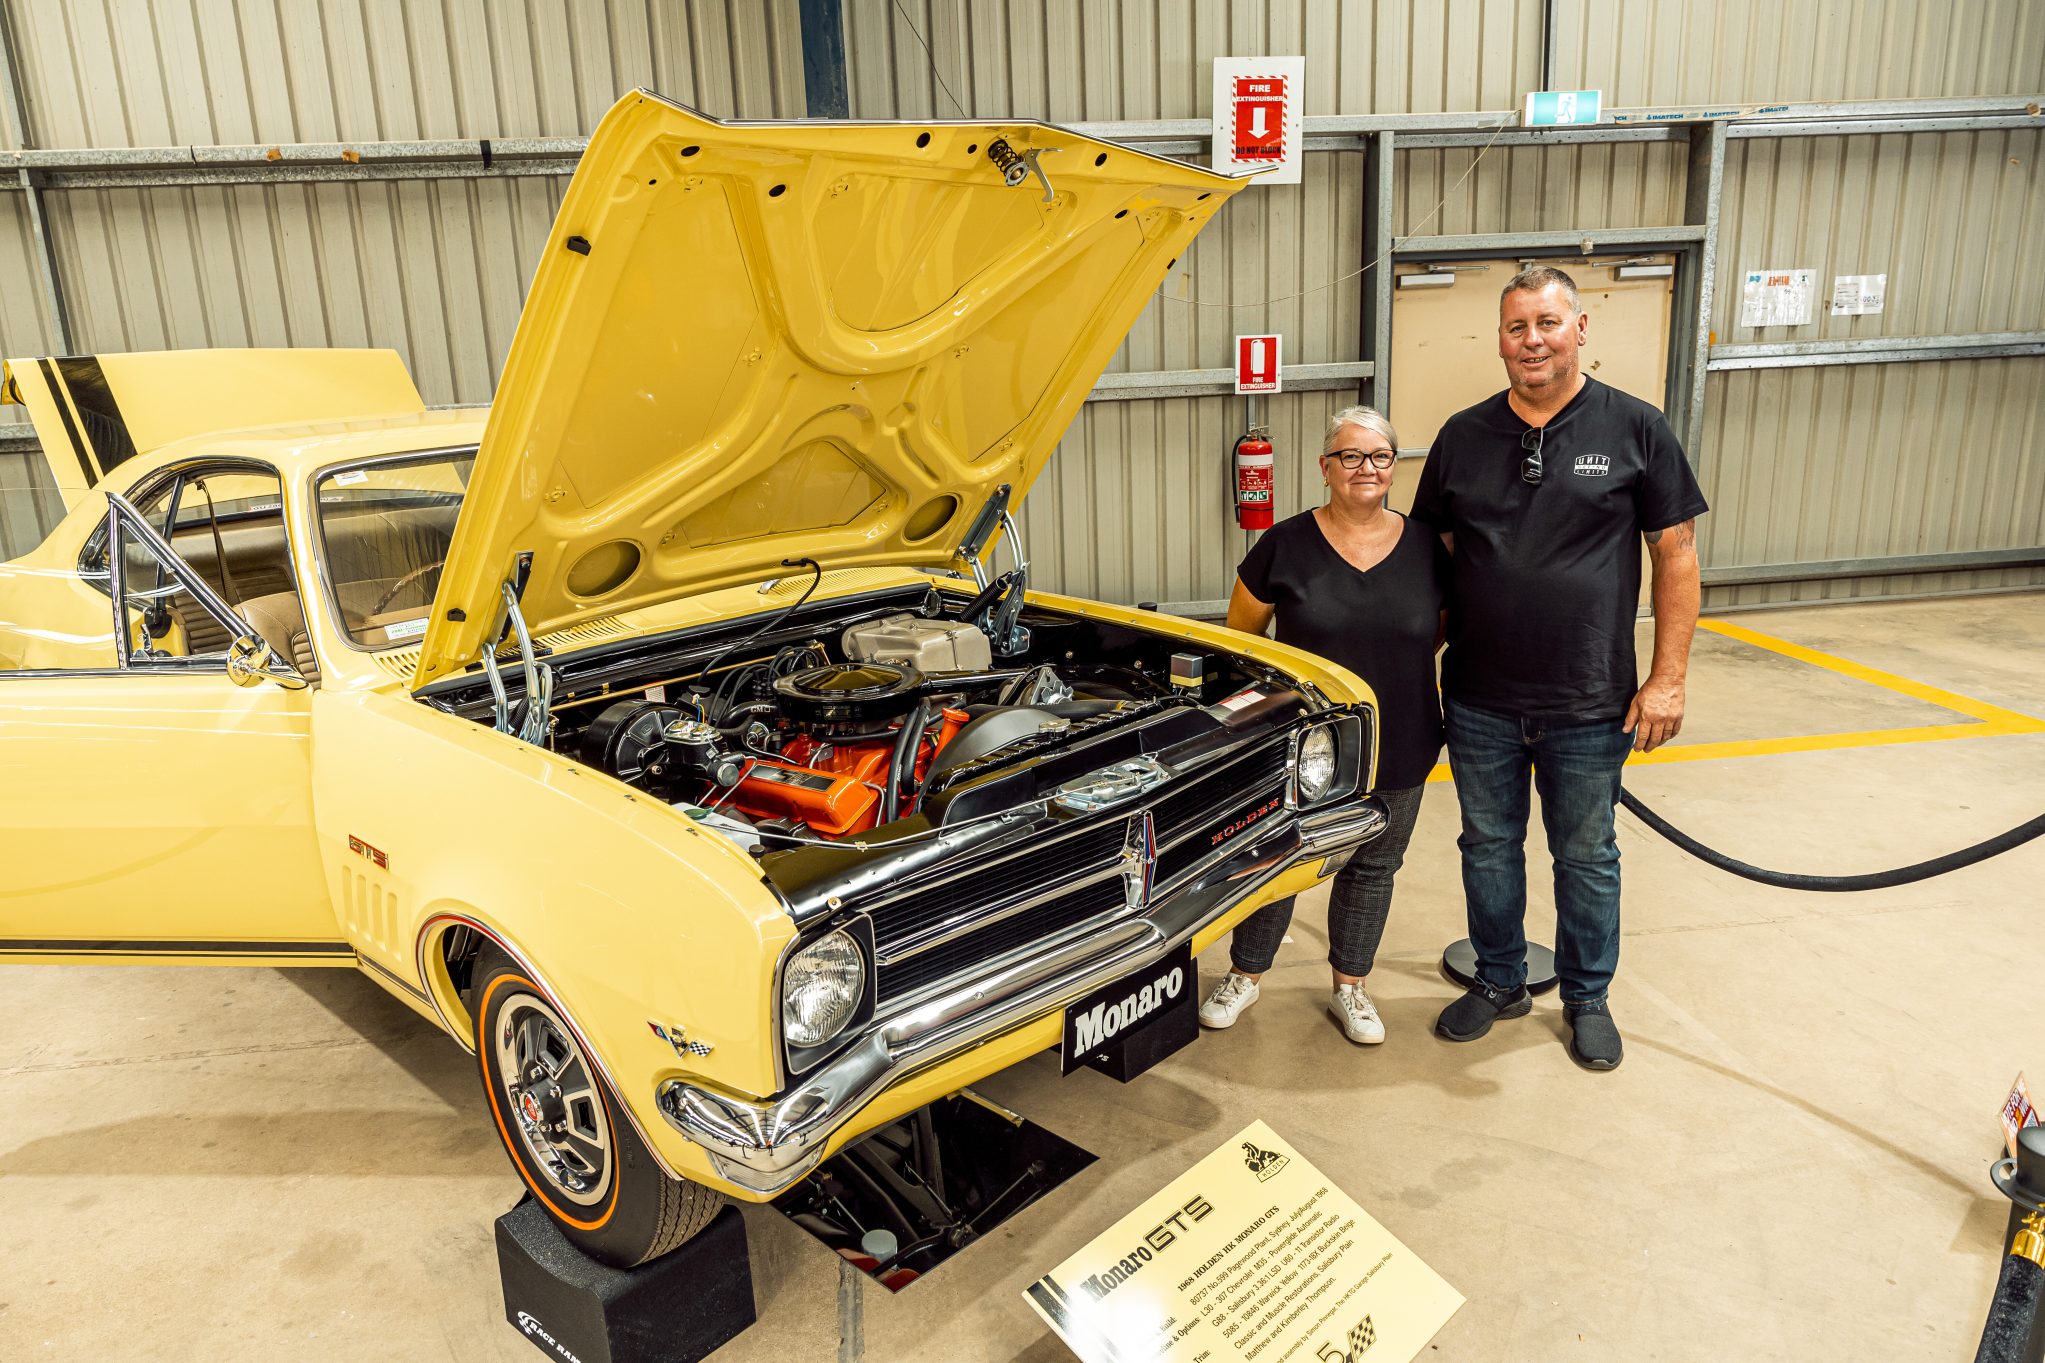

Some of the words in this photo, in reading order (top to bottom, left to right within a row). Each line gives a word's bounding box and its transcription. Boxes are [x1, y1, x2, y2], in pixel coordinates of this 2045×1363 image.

[1249, 84, 1271, 93] FIRE
[1236, 146, 1245, 154] DO
[1246, 146, 1259, 154] NOT
[1260, 146, 1281, 155] BLOCK
[1578, 456, 1607, 464] UNIT
[1211, 797, 1280, 846] HOLDEN
[348, 833, 390, 870] GTS
[1073, 966, 1183, 1059] Monaro
[1261, 1159, 1284, 1177] HOLDEN
[1080, 1244, 1153, 1302] Monaro
[1142, 1193, 1215, 1253] GTS
[1177, 1276, 1194, 1292] 1968
[1192, 1250, 1224, 1278] HOLDEN
[1221, 1240, 1236, 1254] HK
[1233, 1216, 1266, 1244] MONARO
[1264, 1205, 1279, 1218] GTS
[1226, 1247, 1257, 1274] Pagewood
[1278, 1301, 1309, 1328] Kimberley
[529, 1321, 556, 1346] RACE
